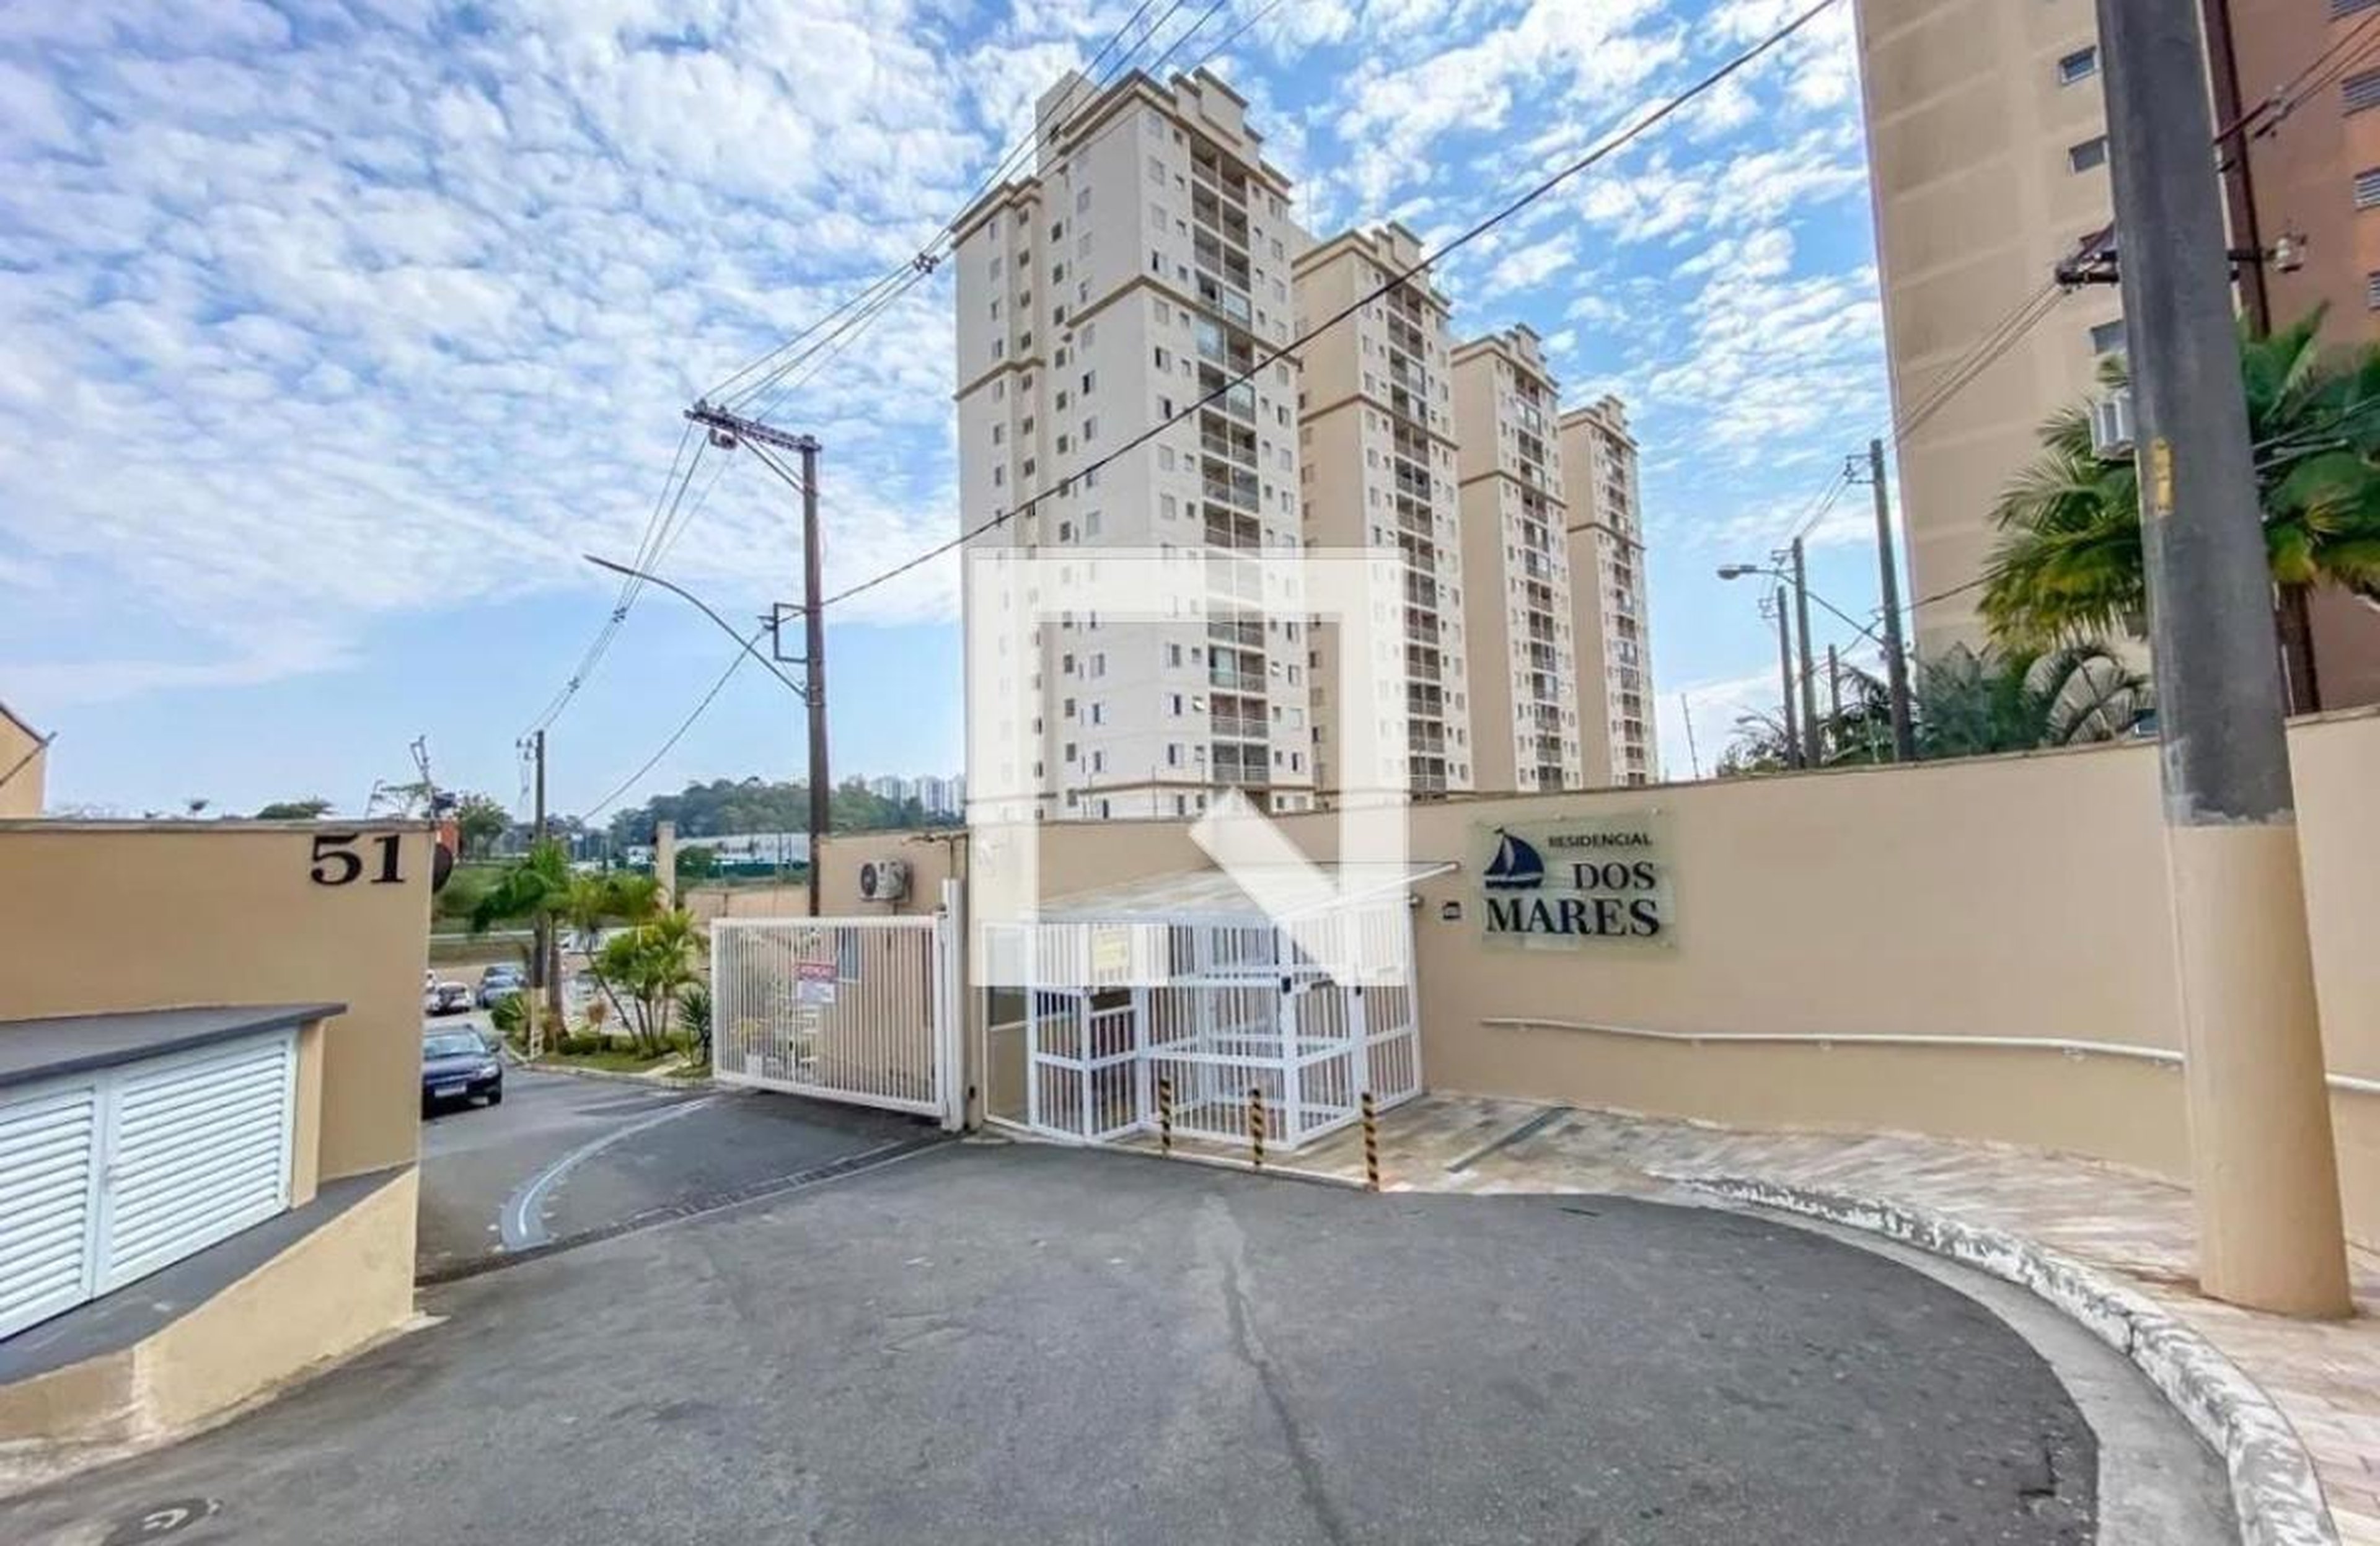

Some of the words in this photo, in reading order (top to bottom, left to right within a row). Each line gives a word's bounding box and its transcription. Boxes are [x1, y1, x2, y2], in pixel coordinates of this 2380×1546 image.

[1548, 832, 1653, 848] RESIDENCIAL
[311, 832, 406, 885] 51
[1572, 861, 1656, 890] DOS
[1485, 897, 1660, 937] MARES
